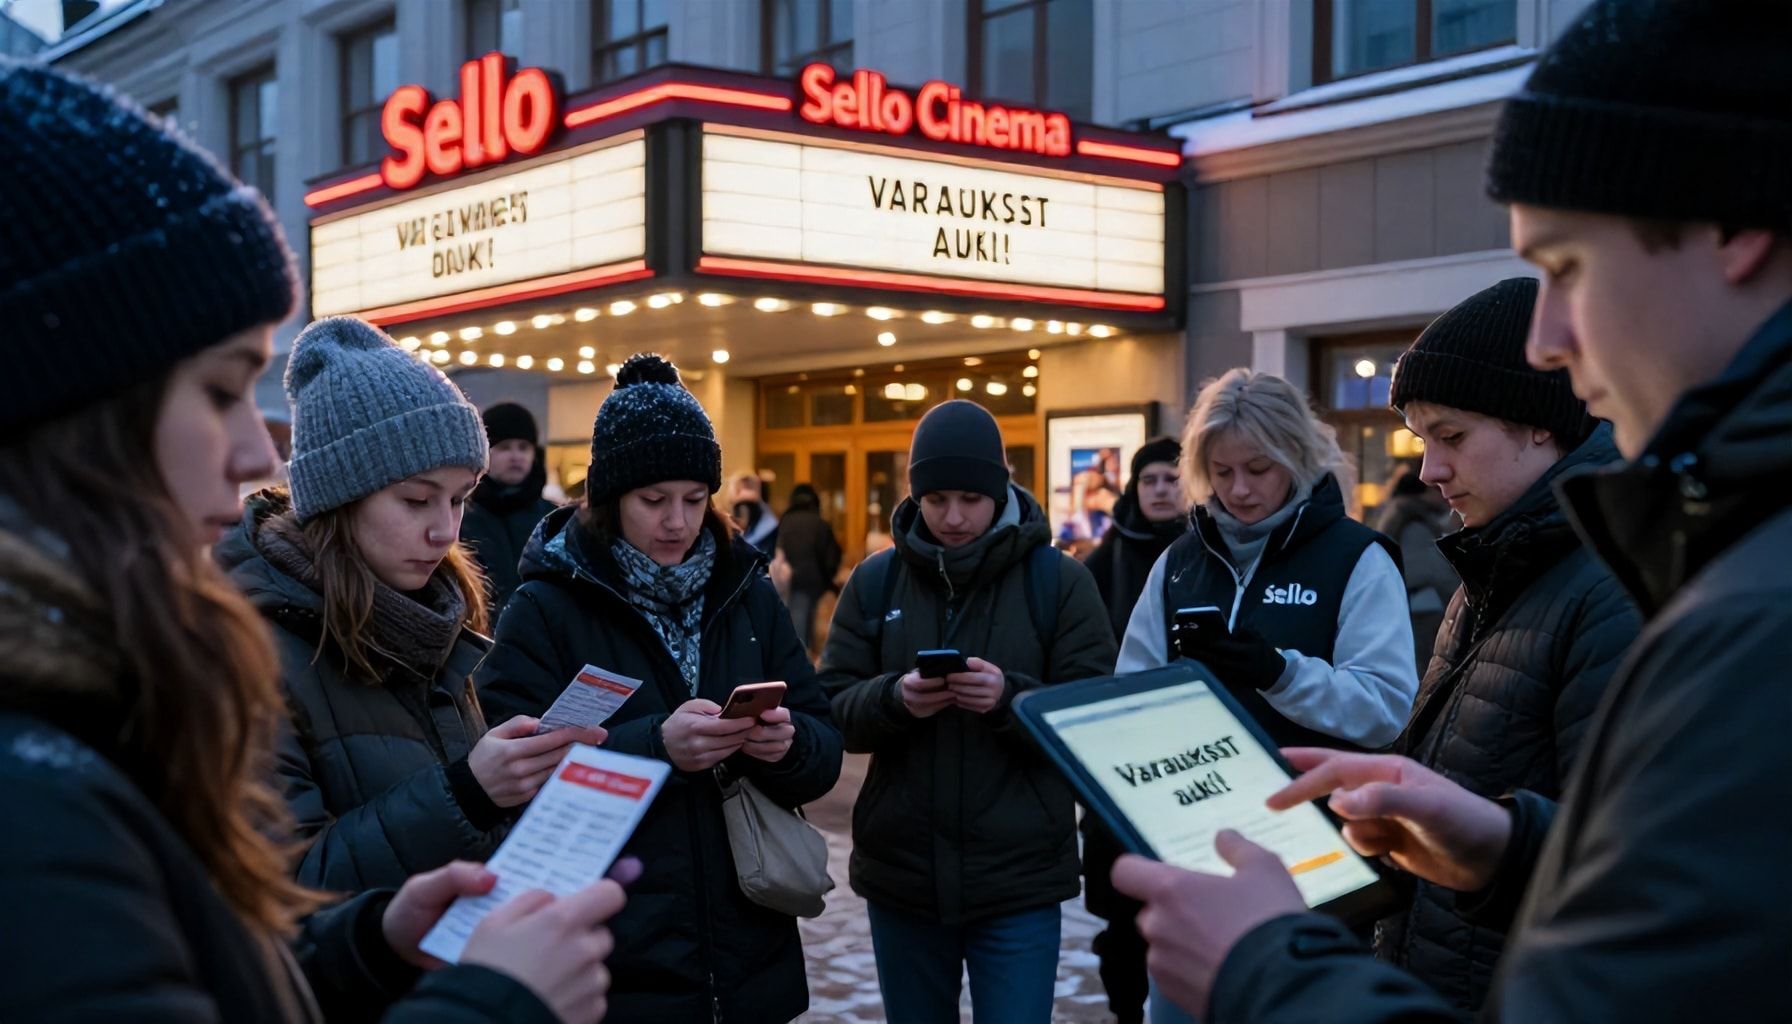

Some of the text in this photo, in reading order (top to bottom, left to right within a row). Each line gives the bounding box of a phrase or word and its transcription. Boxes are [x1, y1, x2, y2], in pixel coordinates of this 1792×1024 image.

[381, 52, 554, 189] Sello
[800, 62, 1071, 156] Sello Cinema
[868, 175, 1049, 228] VARAUKSST
[1262, 582, 1318, 606] Sello
